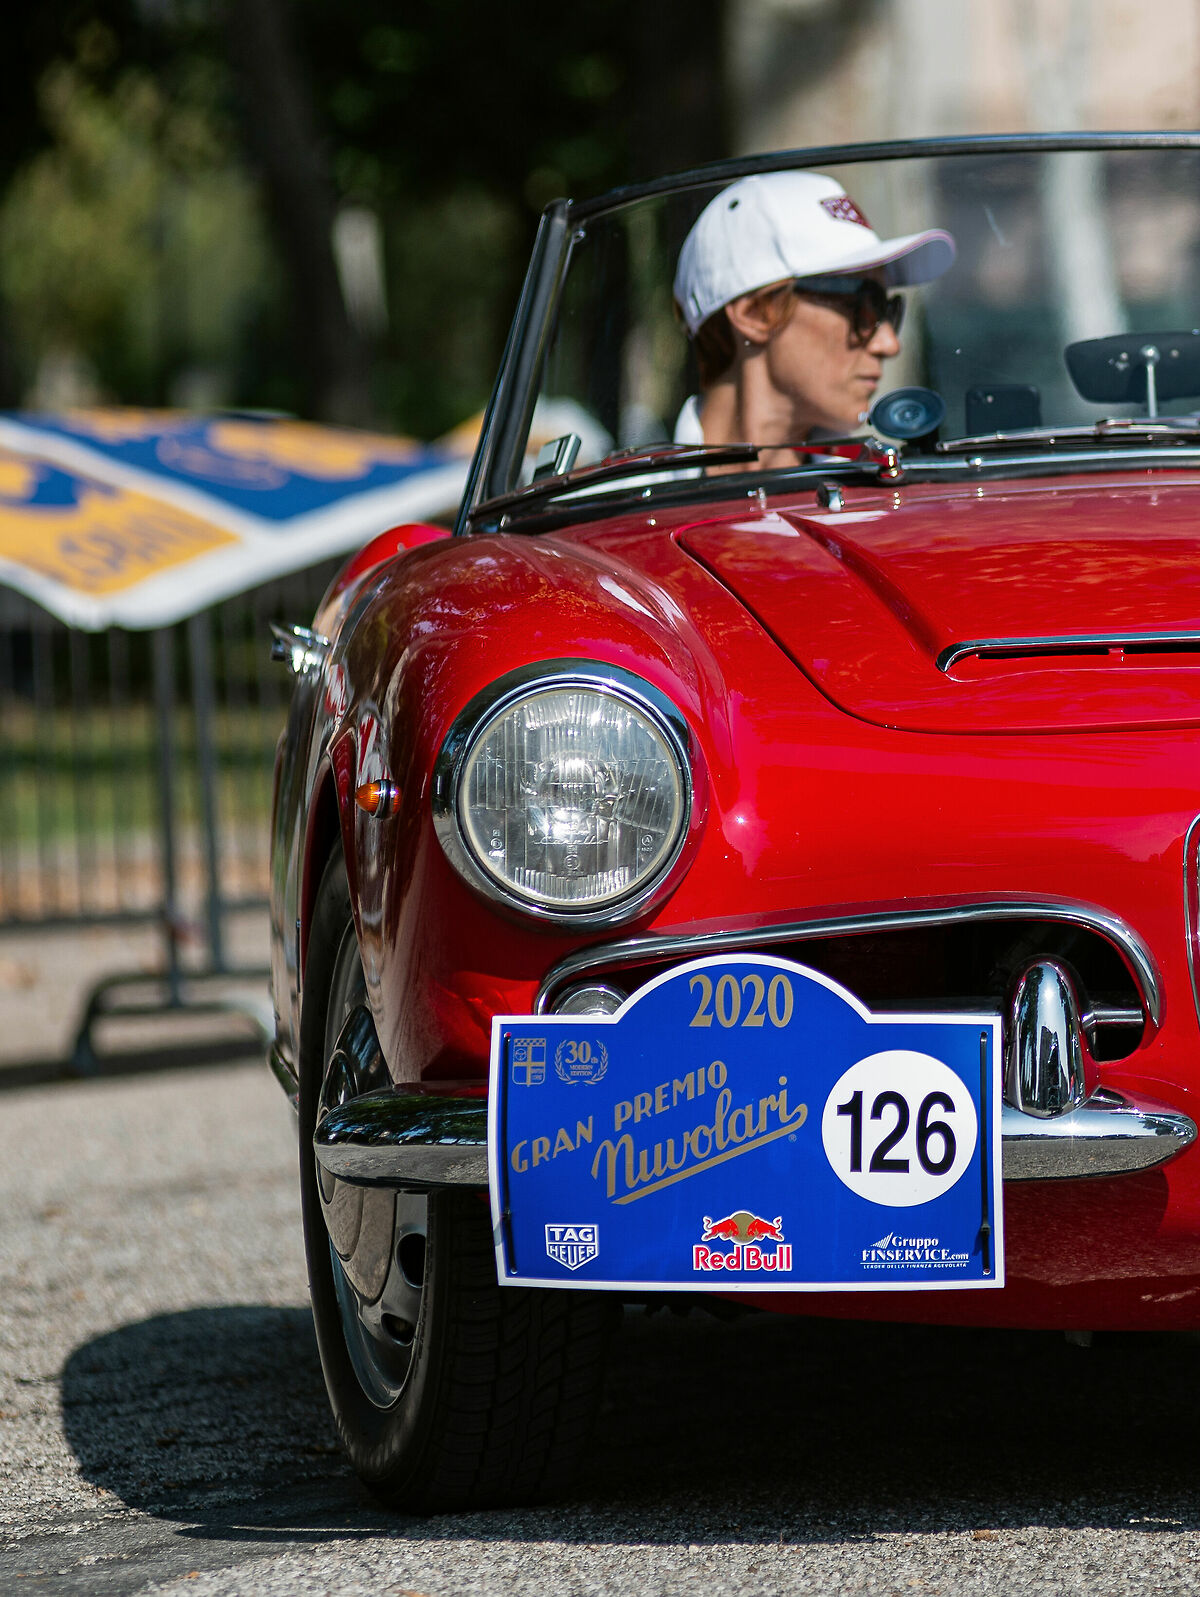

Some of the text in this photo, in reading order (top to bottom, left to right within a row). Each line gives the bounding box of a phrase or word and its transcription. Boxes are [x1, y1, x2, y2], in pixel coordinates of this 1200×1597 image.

[689, 974, 794, 1028] 2020
[511, 1060, 728, 1173] GRAN PREMIO
[591, 1075, 808, 1204] Nuvolari
[836, 1090, 957, 1177] 126
[549, 1228, 593, 1242] TAG
[891, 1236, 939, 1249] Gruppo
[549, 1244, 594, 1267] HEUER
[693, 1244, 793, 1271] Red Bull
[862, 1249, 969, 1261] FINSERVICE.com
